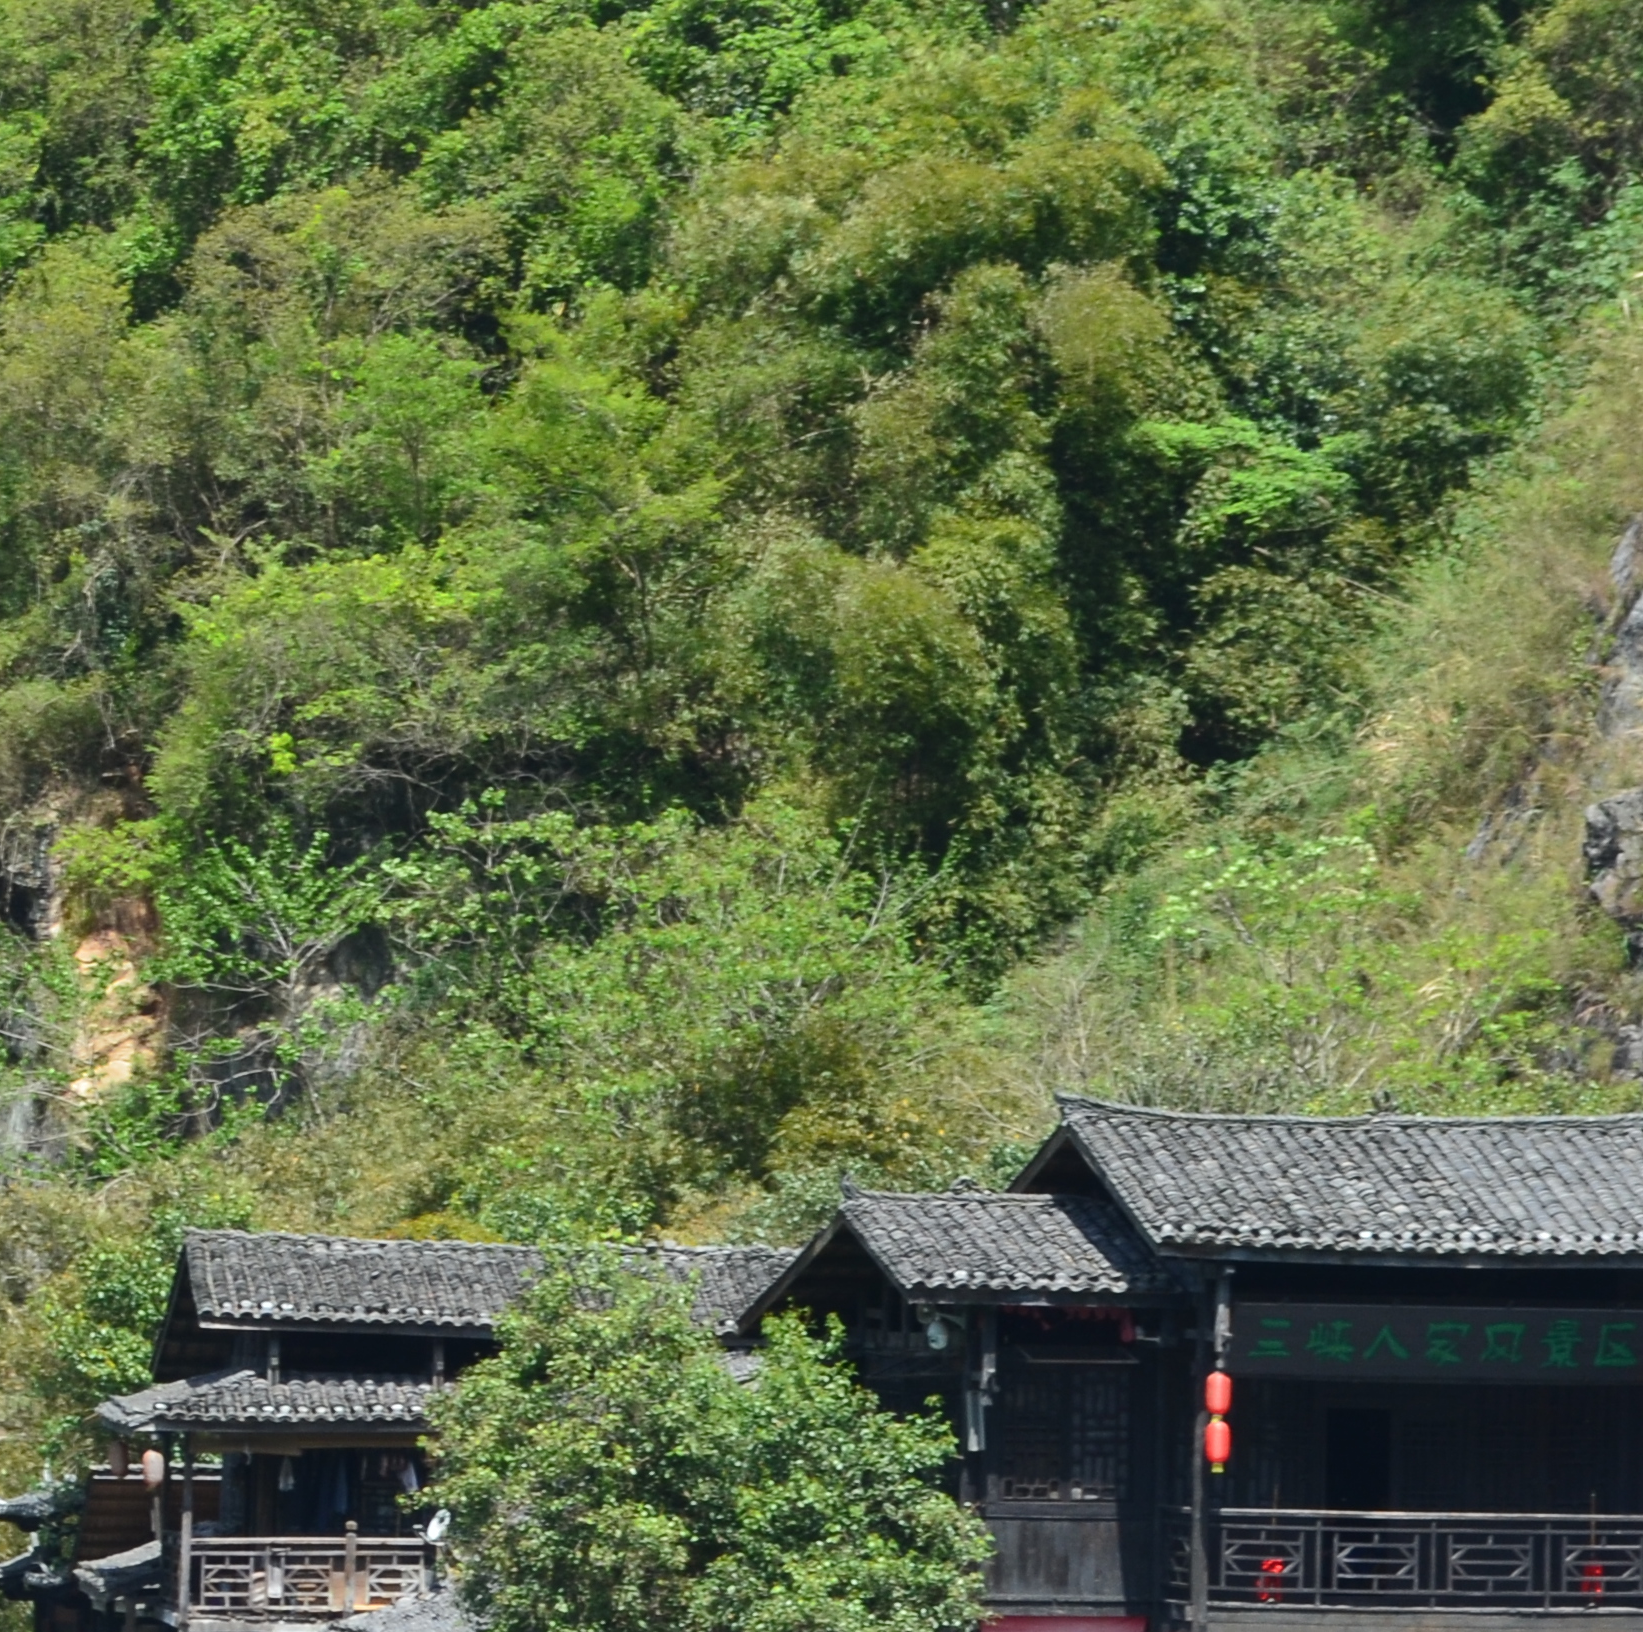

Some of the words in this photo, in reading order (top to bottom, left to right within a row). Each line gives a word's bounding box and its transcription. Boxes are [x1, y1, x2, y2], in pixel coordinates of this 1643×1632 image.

[1247, 1318, 1637, 1368] 三峡人家风景区
